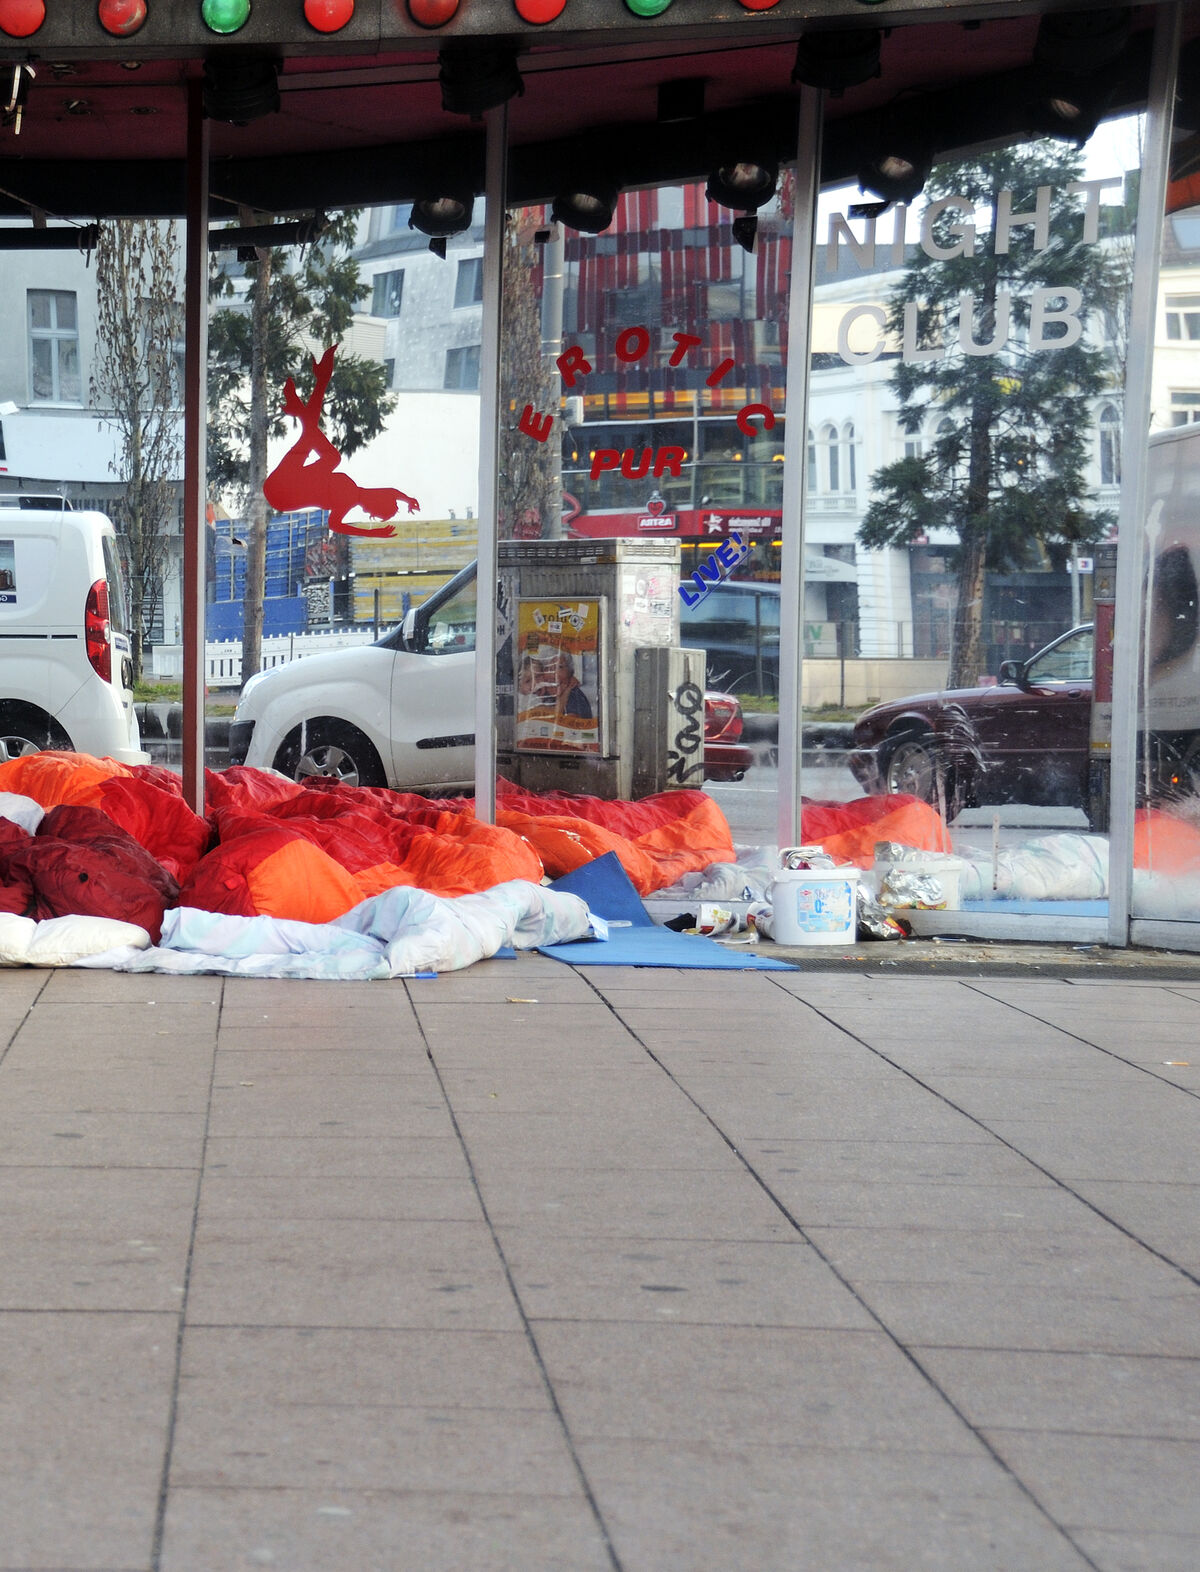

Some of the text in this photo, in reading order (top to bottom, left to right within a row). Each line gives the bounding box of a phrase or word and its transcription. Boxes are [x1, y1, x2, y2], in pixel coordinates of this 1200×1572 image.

[825, 175, 1123, 273] NIGHT
[836, 286, 1084, 367] CLUB
[518, 326, 776, 443] EROTIC
[589, 446, 686, 480] PUR
[678, 531, 750, 608] LIVE!
